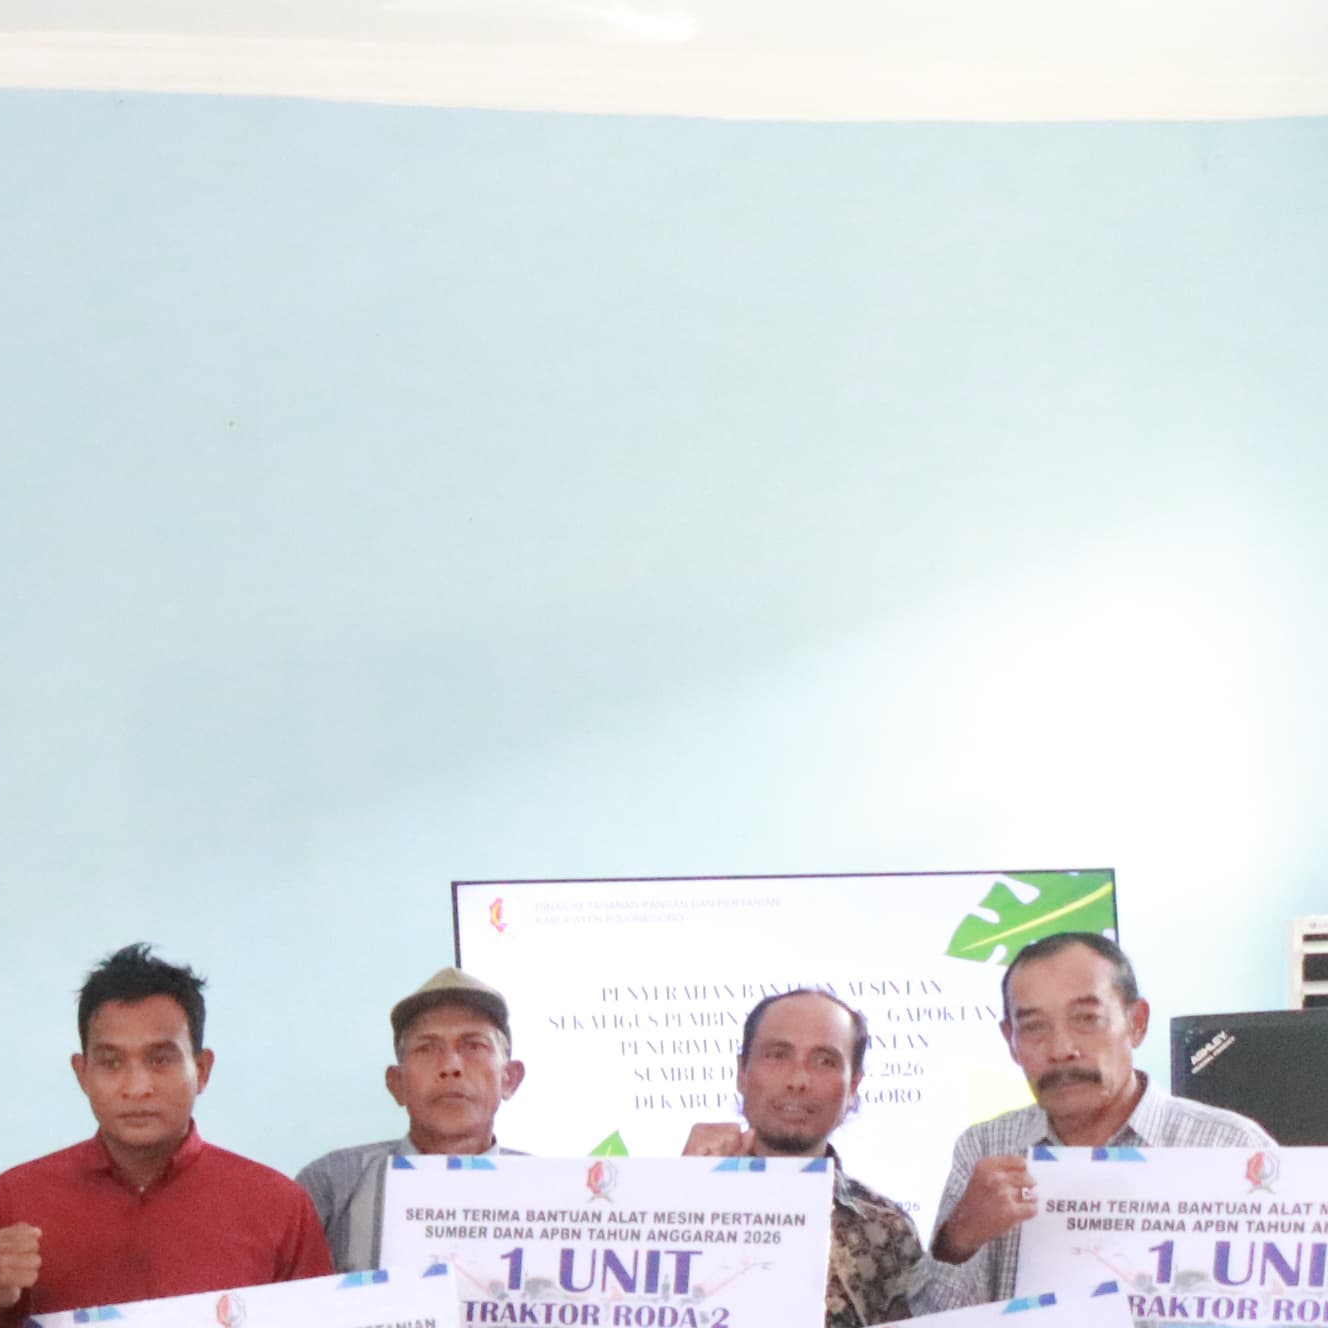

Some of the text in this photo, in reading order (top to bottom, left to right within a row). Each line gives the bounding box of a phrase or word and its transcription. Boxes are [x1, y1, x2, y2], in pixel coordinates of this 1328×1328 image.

[406, 1207, 806, 1227] SERAH TERIMA BANTUAN ALAT MESIN PERTANIAN
[1046, 1199, 1313, 1216] SERAH TERIMA BANTUAN ALAT
[501, 1248, 701, 1295] 1 UNIT
[1149, 1240, 1328, 1288] 1 UNI
[467, 1301, 599, 1326] TRAKTOR
[613, 1305, 697, 1328] RODA
[1129, 1295, 1258, 1320] RAKTOR
